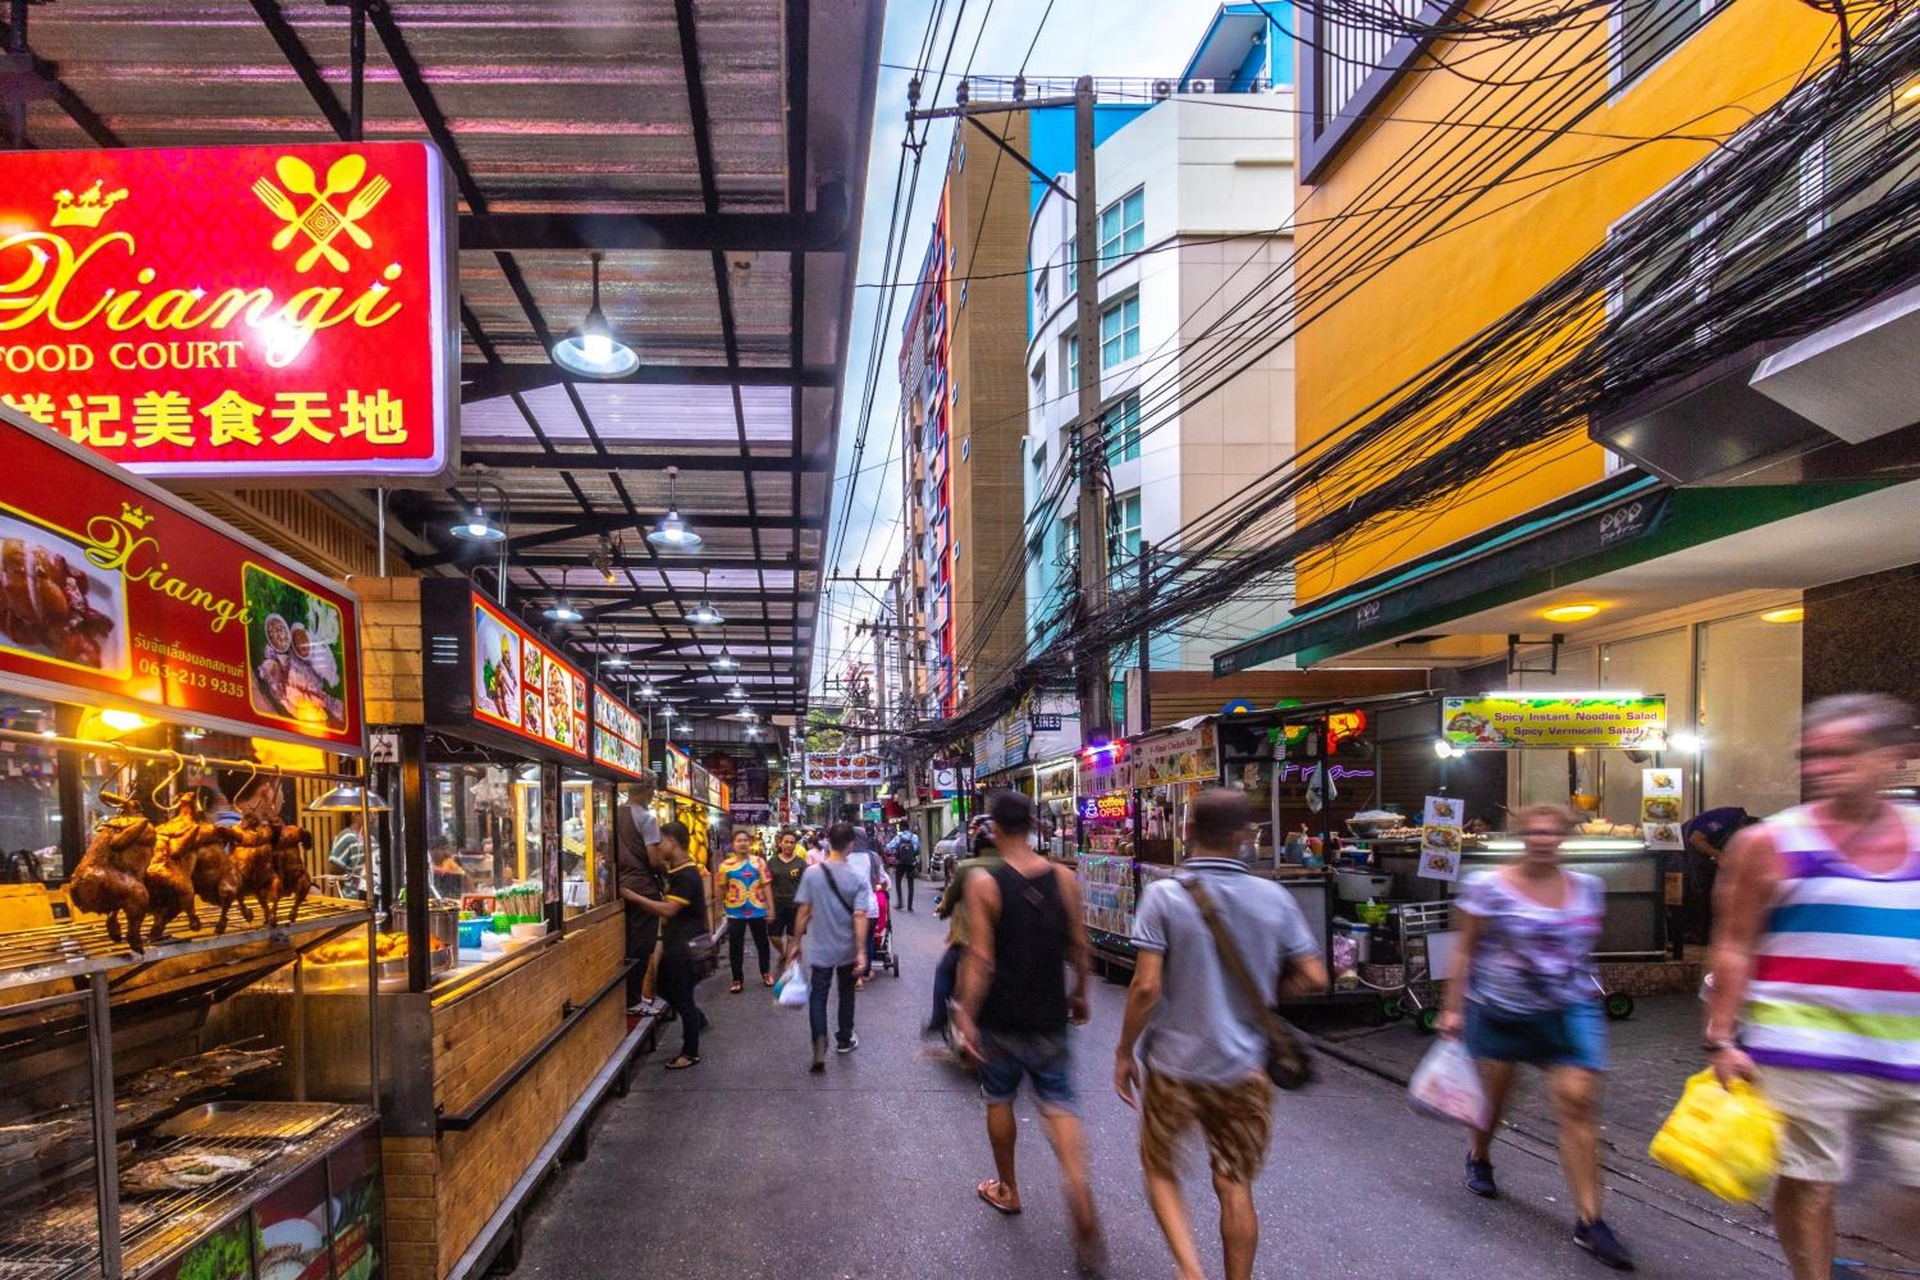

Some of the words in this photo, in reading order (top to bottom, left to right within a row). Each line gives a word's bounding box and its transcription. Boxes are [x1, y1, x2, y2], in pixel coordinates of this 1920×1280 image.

[110, 341, 244, 370] COURT
[139, 658, 206, 688] 063-213
[211, 677, 244, 698] 9335
[1494, 712, 1524, 722] Spicy
[1530, 712, 1569, 721] Instant
[1576, 712, 1621, 721] Noodles
[1627, 711, 1658, 720] Salad
[1513, 726, 1544, 736] Spicy
[1549, 726, 1603, 735] Vermicelli
[1097, 796, 1126, 808] coffee
[1099, 806, 1126, 818] OPEN
